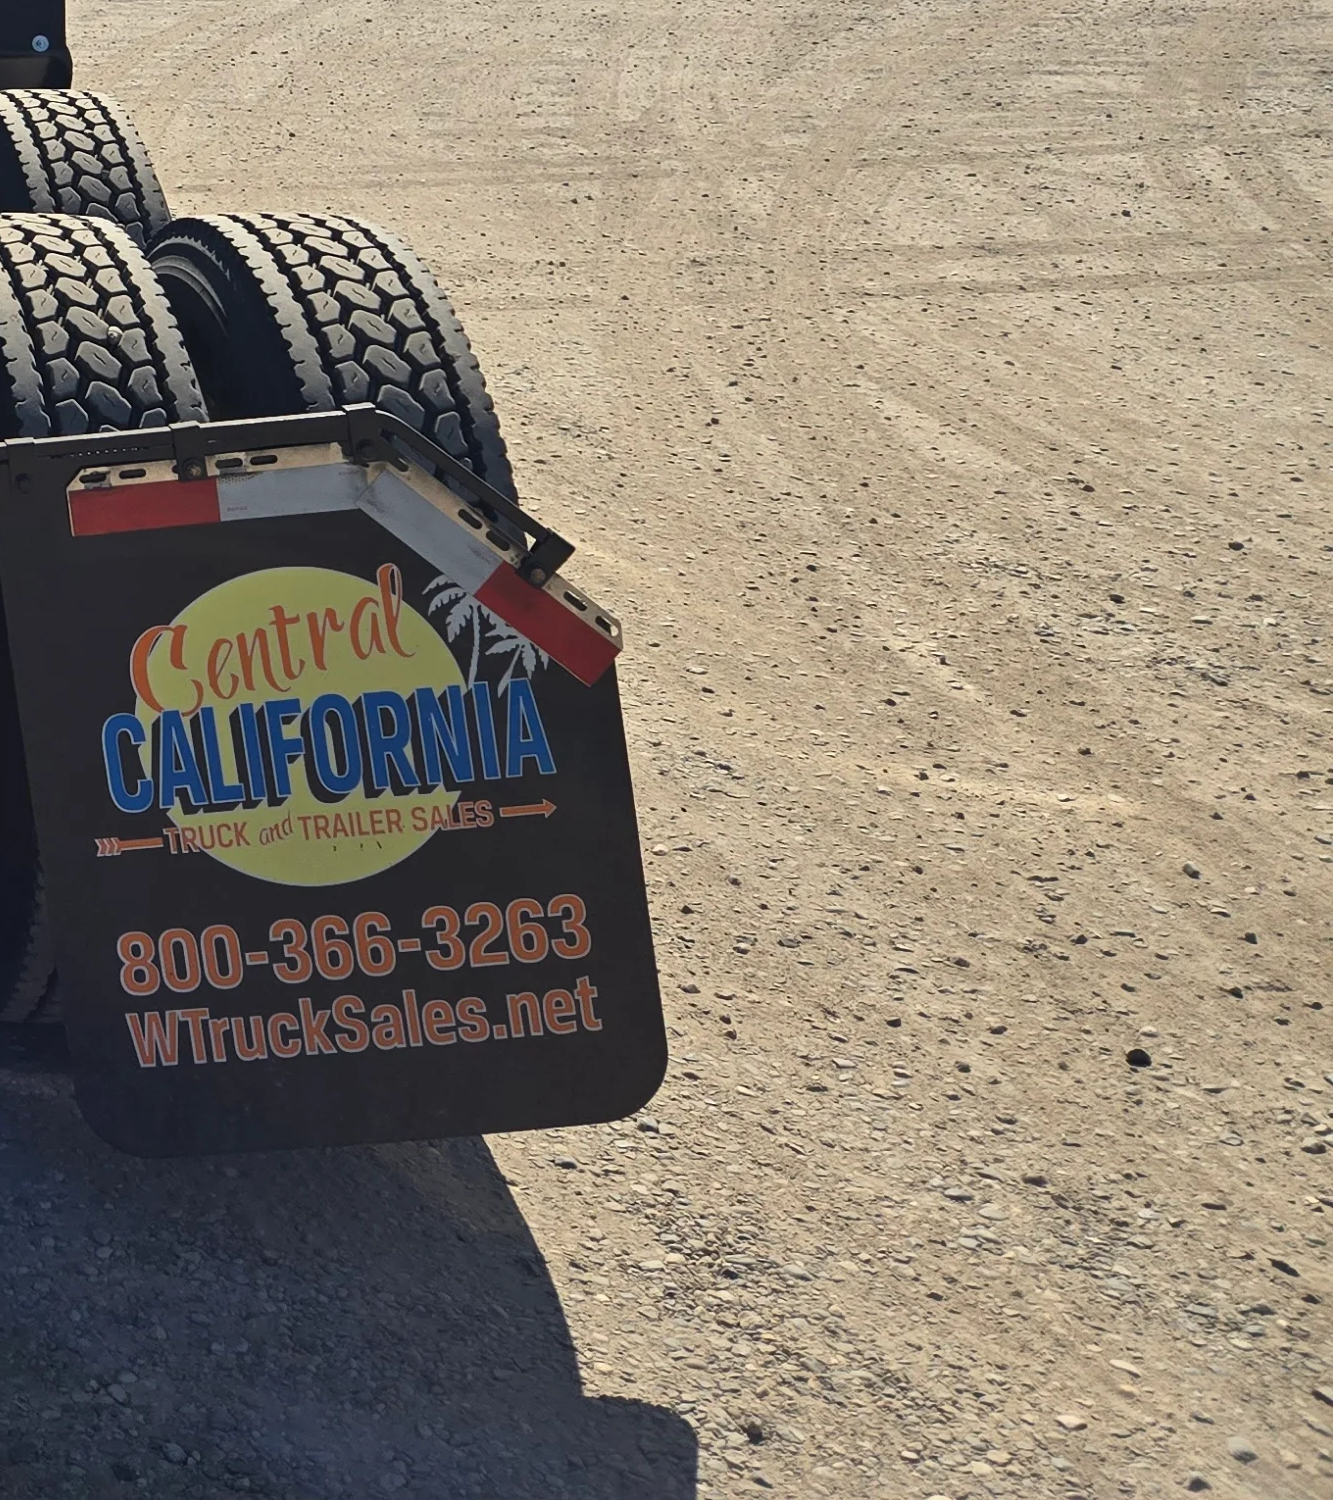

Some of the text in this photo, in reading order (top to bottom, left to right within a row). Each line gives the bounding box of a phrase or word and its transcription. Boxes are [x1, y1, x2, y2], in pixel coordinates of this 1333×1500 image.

[130, 562, 417, 718] Central
[101, 677, 557, 814] CALIFORNIA
[163, 800, 494, 854] TRUCK and TRAILER SALES
[116, 894, 592, 996] 800-366-3263
[126, 975, 603, 1068] WTruckSales.net
